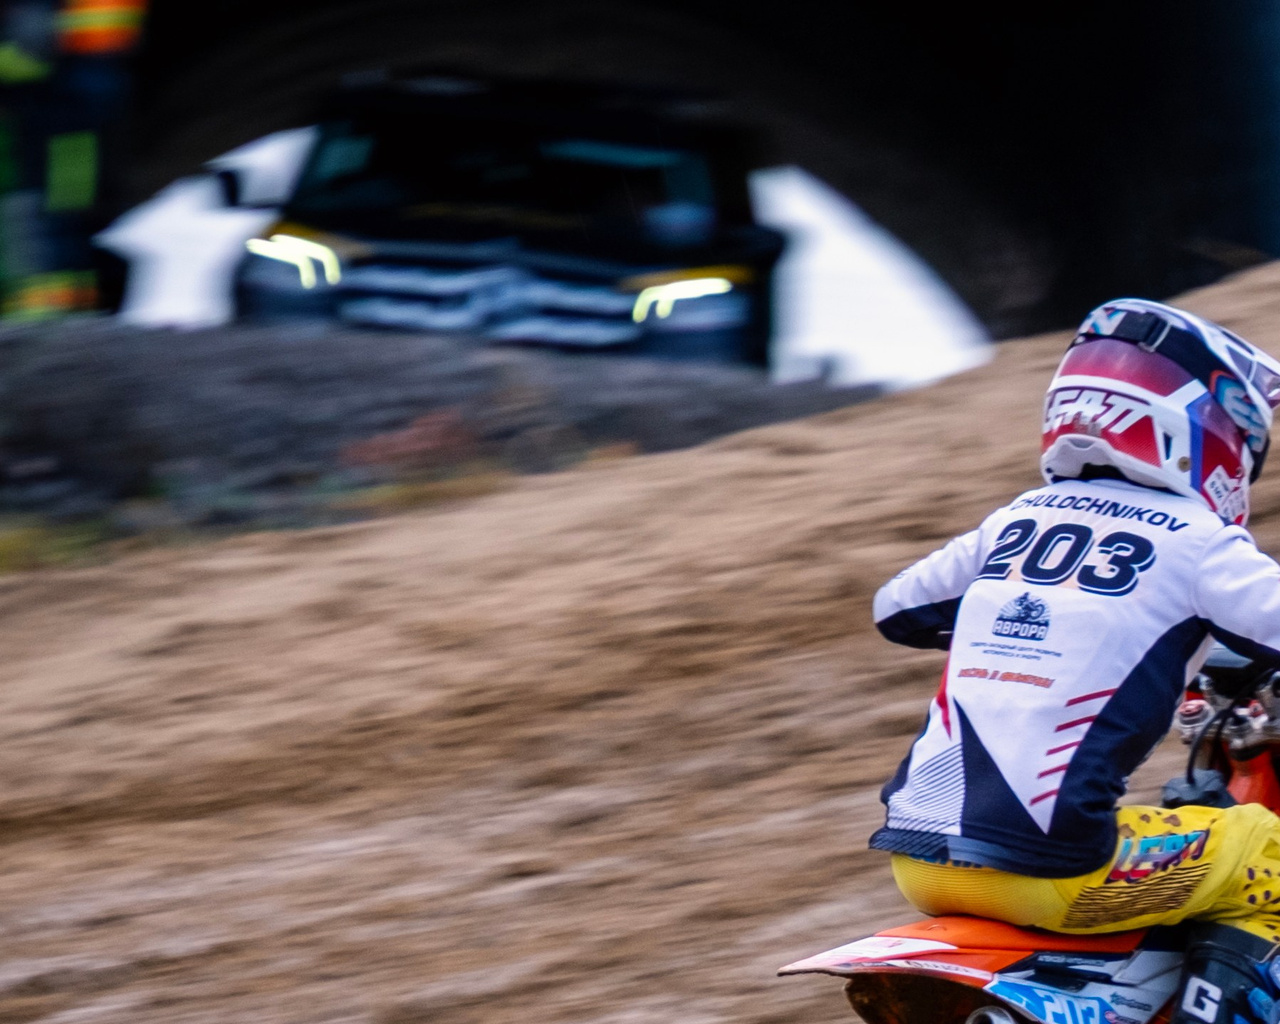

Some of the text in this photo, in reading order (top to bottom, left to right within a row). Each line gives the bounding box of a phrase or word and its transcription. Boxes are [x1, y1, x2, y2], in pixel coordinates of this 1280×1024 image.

[975, 518, 1157, 597] 203
[992, 619, 1049, 640] АВРОРА
[1181, 976, 1223, 1024] G
